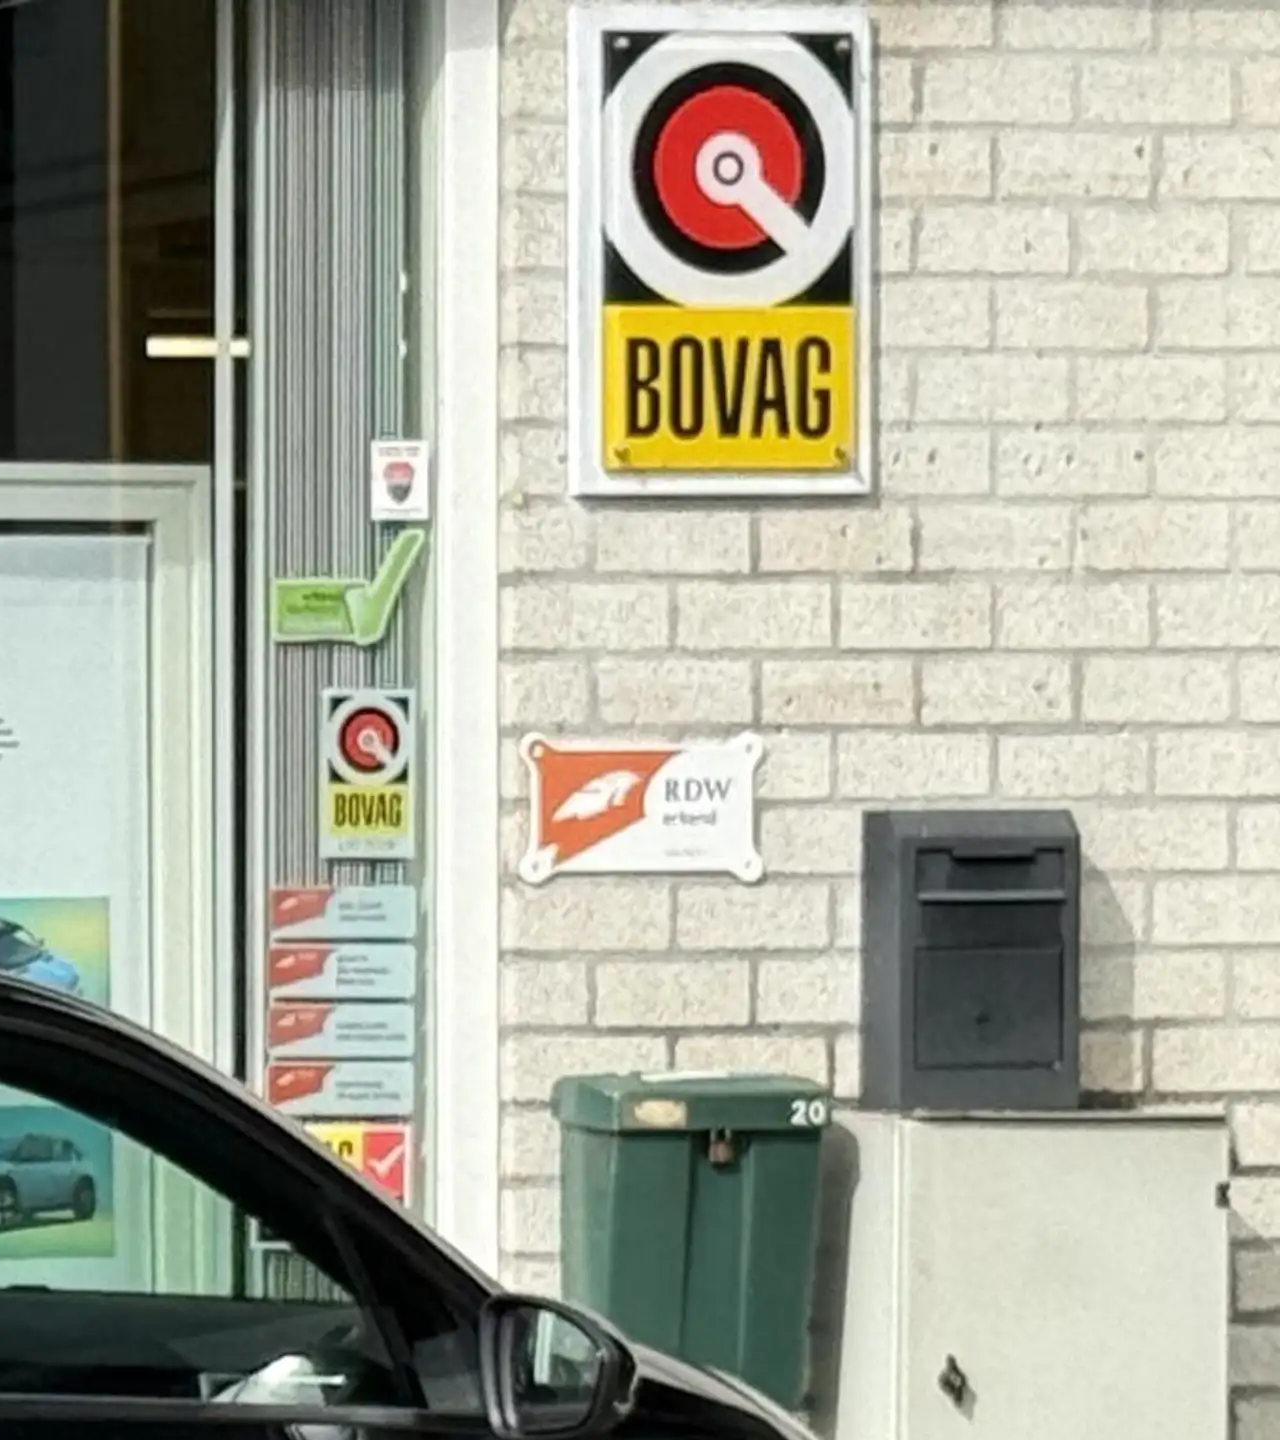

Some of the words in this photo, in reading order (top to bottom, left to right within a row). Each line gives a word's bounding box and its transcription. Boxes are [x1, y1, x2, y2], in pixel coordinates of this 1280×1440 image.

[626, 336, 832, 440] BOVAG
[664, 777, 732, 803] RDW
[334, 793, 402, 827] BOVAG
[790, 1099, 826, 1126] 20
